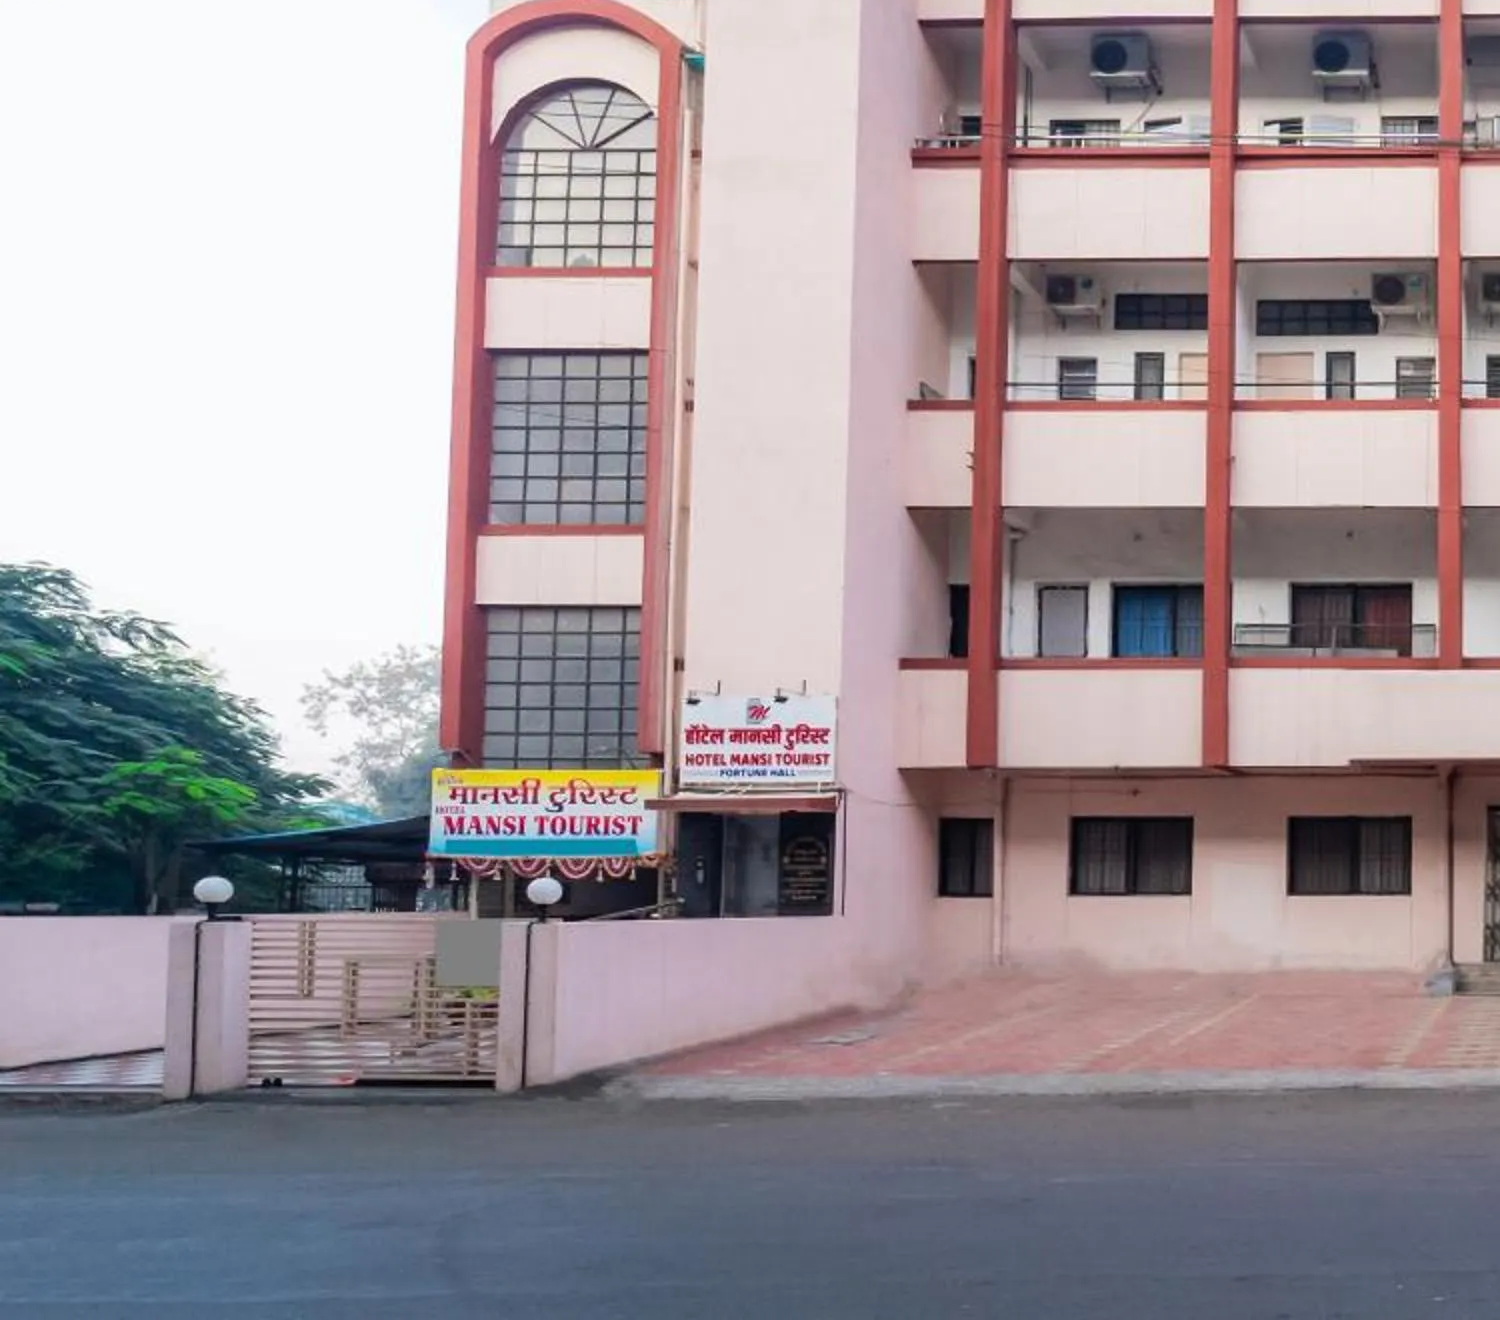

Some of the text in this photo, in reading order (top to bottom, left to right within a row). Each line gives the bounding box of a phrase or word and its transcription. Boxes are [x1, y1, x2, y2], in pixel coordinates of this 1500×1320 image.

[685, 724, 831, 750] हॉटेल मानसी टुरिस्ट
[685, 753, 831, 766] HOTEL MANSI TOURIST
[448, 777, 638, 812] मानसी टुरिस्ट
[443, 815, 643, 836] MANSI TOURIST
